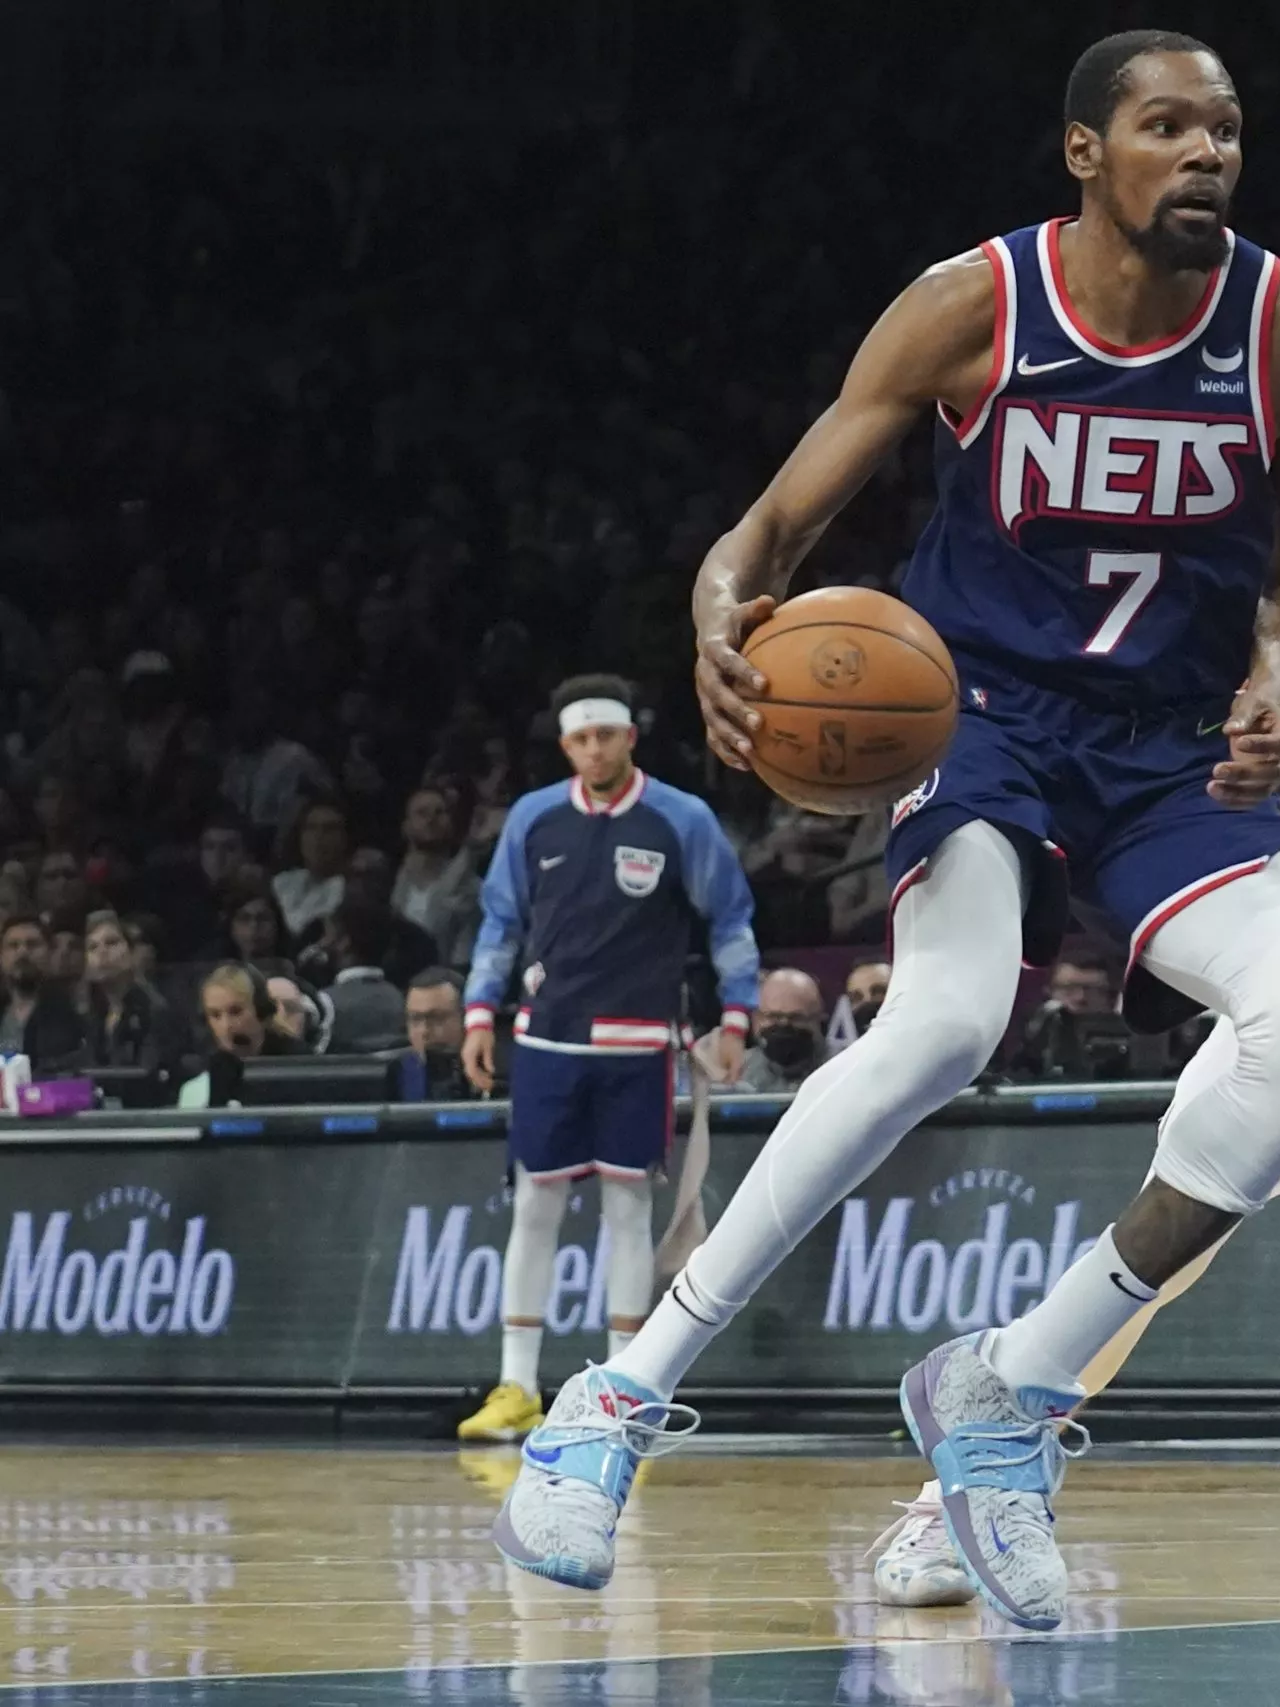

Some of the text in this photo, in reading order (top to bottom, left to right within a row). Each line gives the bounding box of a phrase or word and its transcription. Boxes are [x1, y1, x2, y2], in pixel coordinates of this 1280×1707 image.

[1199, 379, 1244, 395] Webull
[996, 403, 1250, 535] NETS
[1083, 550, 1161, 656] 7
[929, 1167, 1036, 1207] CERVEZA
[0, 1210, 233, 1335] Modelo
[386, 1204, 612, 1335] Moel
[826, 1197, 1100, 1333] Model
